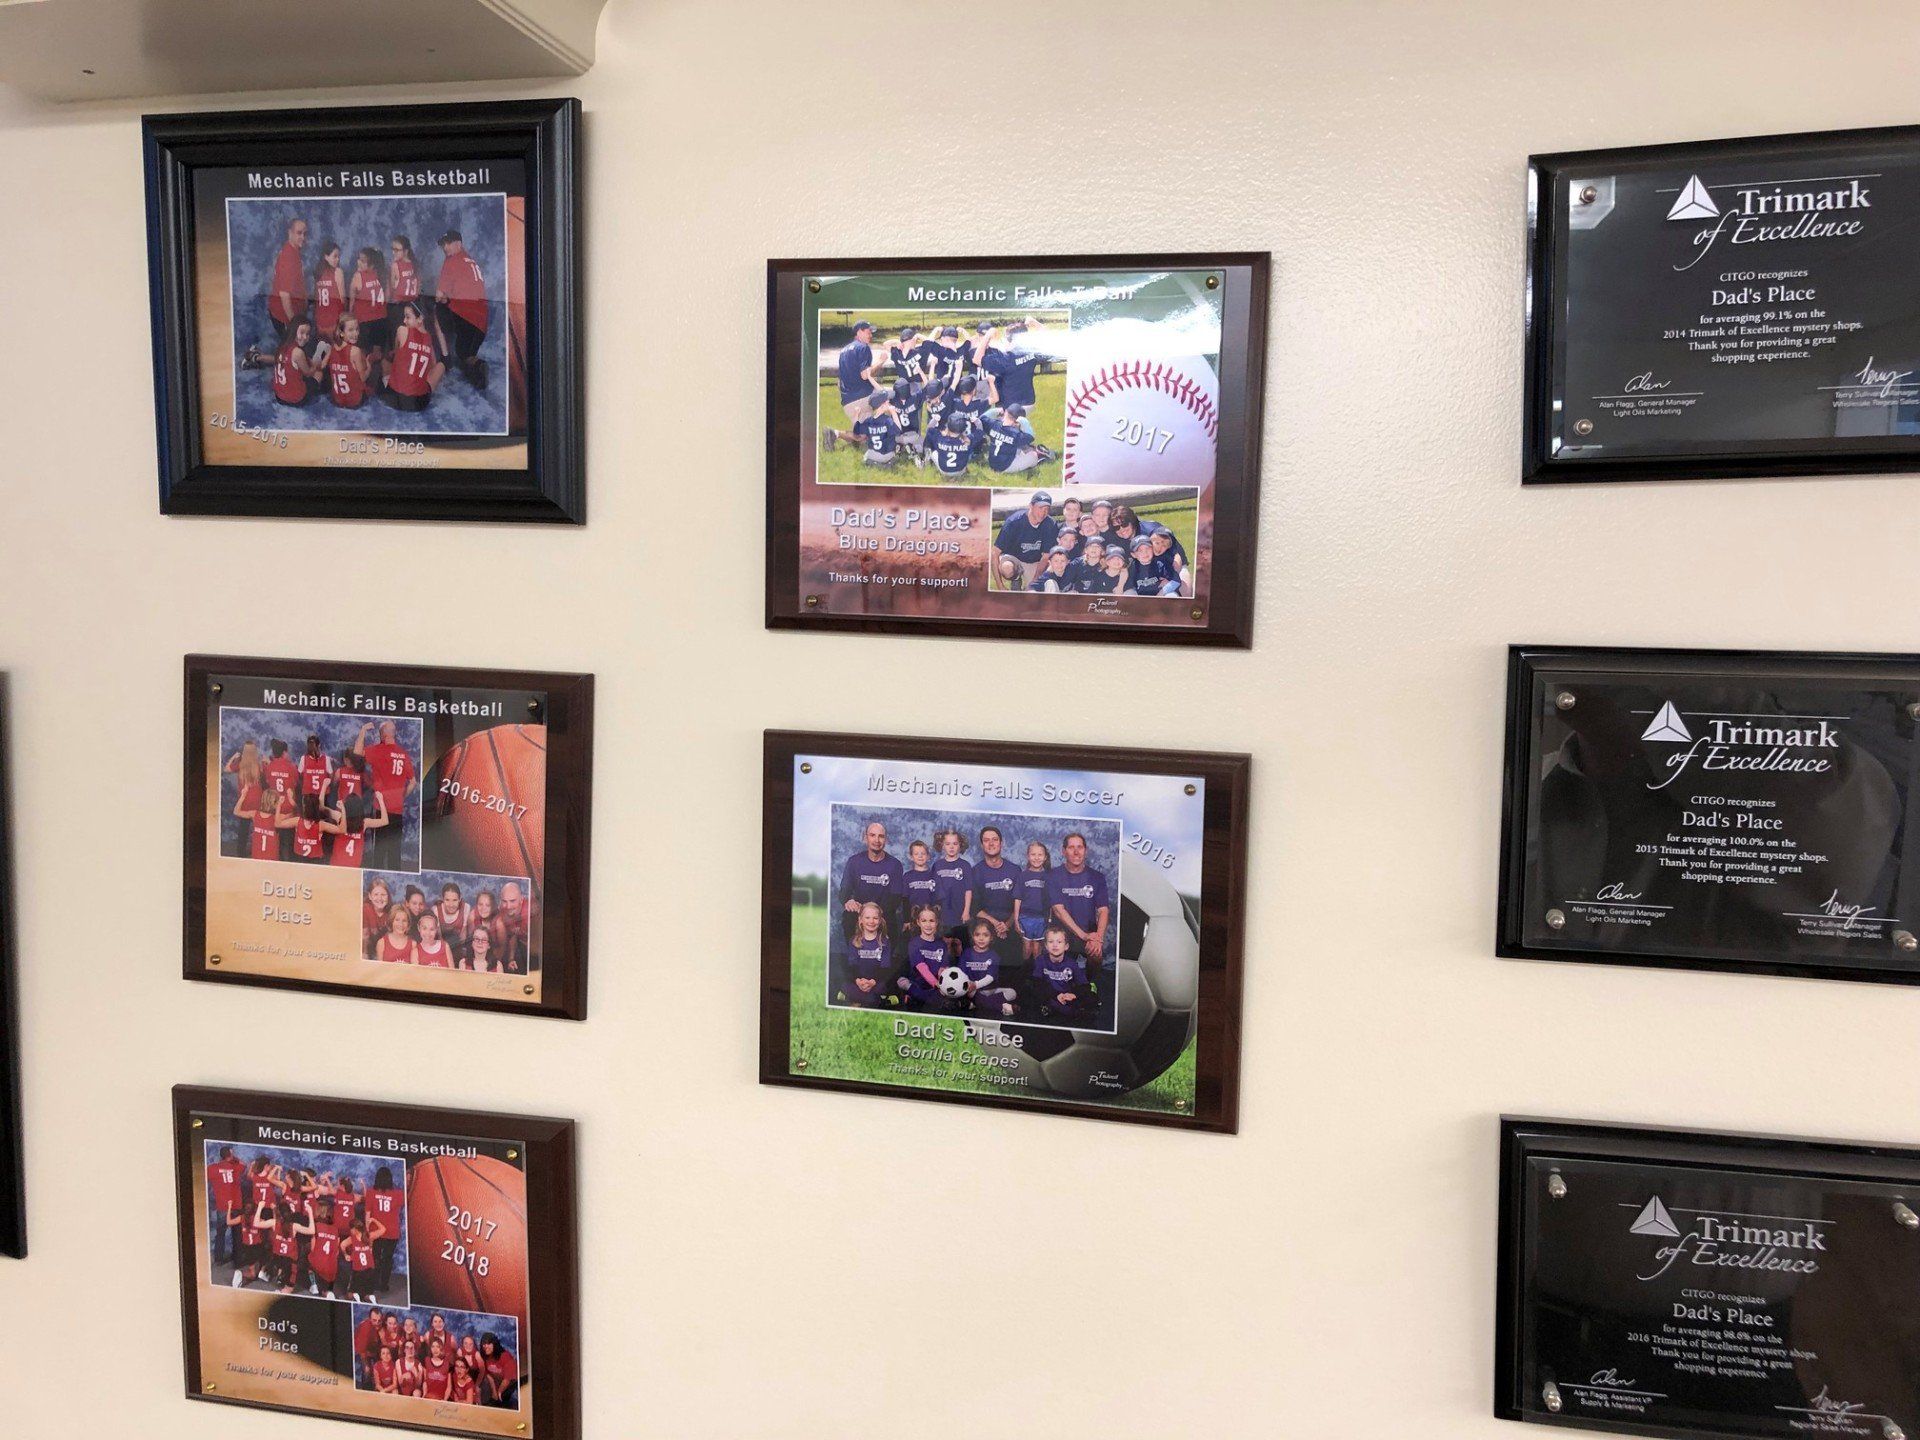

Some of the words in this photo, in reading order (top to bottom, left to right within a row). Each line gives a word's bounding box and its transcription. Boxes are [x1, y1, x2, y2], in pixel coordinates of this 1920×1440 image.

[249, 172, 333, 189] Mechanic
[341, 171, 385, 187] Falls
[392, 168, 490, 187] Basketball
[1737, 180, 1871, 216] Trimark
[1673, 209, 1739, 271] of
[1731, 213, 1864, 244] Excellence
[1720, 272, 1755, 282] CITGO
[1757, 270, 1808, 280] recognizes
[370, 287, 385, 306] 14
[908, 286, 1007, 302] Mechanic
[1015, 286, 1063, 301] Falls
[1712, 287, 1761, 306] Dad's
[1767, 286, 1816, 302] Place
[1700, 315, 1713, 324] for
[1715, 313, 1761, 324] averaging
[1763, 311, 1793, 321] 99.1%
[1810, 309, 1826, 318] the
[1663, 330, 1686, 339] 2014
[1689, 327, 1725, 338] Trimark
[1728, 326, 1738, 336] of
[1740, 324, 1790, 335] Excellence
[1793, 324, 1830, 333] mystery
[1833, 321, 1864, 330] shops.
[1688, 342, 1718, 351] Thank
[1720, 342, 1738, 351] you
[1740, 339, 1754, 348] for
[1756, 337, 1802, 349] providing
[1812, 336, 1836, 346] great
[409, 352, 429, 378] 17
[1711, 353, 1755, 364] shopping
[1757, 351, 1810, 362] experience.
[872, 436, 882, 450] 5
[1111, 416, 1174, 454] 2017
[339, 438, 379, 454] Dad's
[385, 438, 425, 455] Place
[946, 452, 957, 467] 2
[831, 507, 897, 528] Dad's
[905, 509, 971, 531] Place
[839, 535, 879, 550] Blue
[885, 537, 961, 555] Dragons
[829, 572, 869, 583] Thanks
[872, 574, 888, 584] for
[892, 577, 917, 587] your
[921, 578, 968, 588] support!
[263, 689, 347, 708] Mechanic
[353, 694, 397, 711] Falls
[405, 697, 503, 716] Basketball
[1709, 720, 1839, 748] Trimark
[1647, 737, 1711, 789] of
[1702, 746, 1832, 773] Excellence
[276, 779, 284, 792] 6
[312, 776, 320, 789] 5
[867, 773, 973, 797] Mechanic
[980, 780, 1034, 800] Falls
[1041, 783, 1124, 806] Soccer
[440, 779, 527, 820] 2016-2017
[1691, 795, 1725, 805] CITGO
[1727, 799, 1776, 808] recognizes
[1682, 811, 1730, 828] Dad's
[1736, 813, 1783, 830] Place
[345, 840, 355, 856] 4
[1667, 833, 1680, 842] for
[1682, 836, 1727, 846] averaging
[1729, 837, 1764, 846] 100.0%
[1766, 839, 1779, 847] on
[1781, 839, 1796, 848] the
[1127, 832, 1177, 870] 2016
[1635, 845, 1657, 853] 2015
[1660, 845, 1695, 855] Trimark
[1697, 847, 1709, 856] of
[1709, 848, 1758, 858] Excellence
[1760, 852, 1797, 862] mystery
[1799, 852, 1829, 862] shops.
[1659, 858, 1688, 867] Thank
[1690, 861, 1707, 869] you
[1709, 860, 1723, 869] for
[1725, 862, 1769, 873] providing
[1779, 865, 1802, 875] great
[1681, 872, 1724, 882] shopping
[1725, 875, 1777, 885] experience.
[262, 880, 313, 900] Dad's
[262, 904, 312, 926] Place
[893, 1019, 955, 1042] Dad's
[963, 1024, 1025, 1048] Place
[898, 1044, 953, 1063] Gorilla
[959, 1051, 1020, 1069] Grapes
[889, 1063, 928, 1076] Thanks
[932, 1067, 948, 1078] for
[951, 1071, 977, 1082] your
[979, 1073, 1028, 1086] support!
[258, 1126, 336, 1145] Mechanic
[342, 1135, 381, 1150] Falls
[387, 1139, 477, 1159] Basketball
[343, 1206, 350, 1217] 2
[379, 1199, 390, 1212] 18
[448, 1206, 497, 1240] 2017
[1696, 1217, 1828, 1251] Trimark
[323, 1241, 331, 1255] 4
[441, 1240, 489, 1276] 2018
[1637, 1232, 1699, 1281] of
[1692, 1241, 1820, 1273] Excellence
[1681, 1288, 1715, 1300] CITGO
[1717, 1293, 1766, 1305] recognizes
[1673, 1303, 1721, 1322] Dad's
[1727, 1307, 1774, 1327] Place
[258, 1317, 298, 1334] Dad's
[1663, 1324, 1676, 1333] for
[1678, 1327, 1722, 1339] averaging
[1753, 1334, 1766, 1343] on
[1767, 1334, 1783, 1345] the
[259, 1337, 298, 1353] Place
[1627, 1332, 1649, 1343] 2016
[1652, 1335, 1687, 1347] Trimark
[1689, 1338, 1700, 1347] of
[1701, 1340, 1749, 1353] Excellence
[1651, 1347, 1680, 1358] Thank
[1682, 1351, 1700, 1361] you
[1702, 1351, 1715, 1361] for
[1717, 1353, 1761, 1367] providing
[1770, 1360, 1793, 1369] great
[1674, 1362, 1716, 1376] shopping
